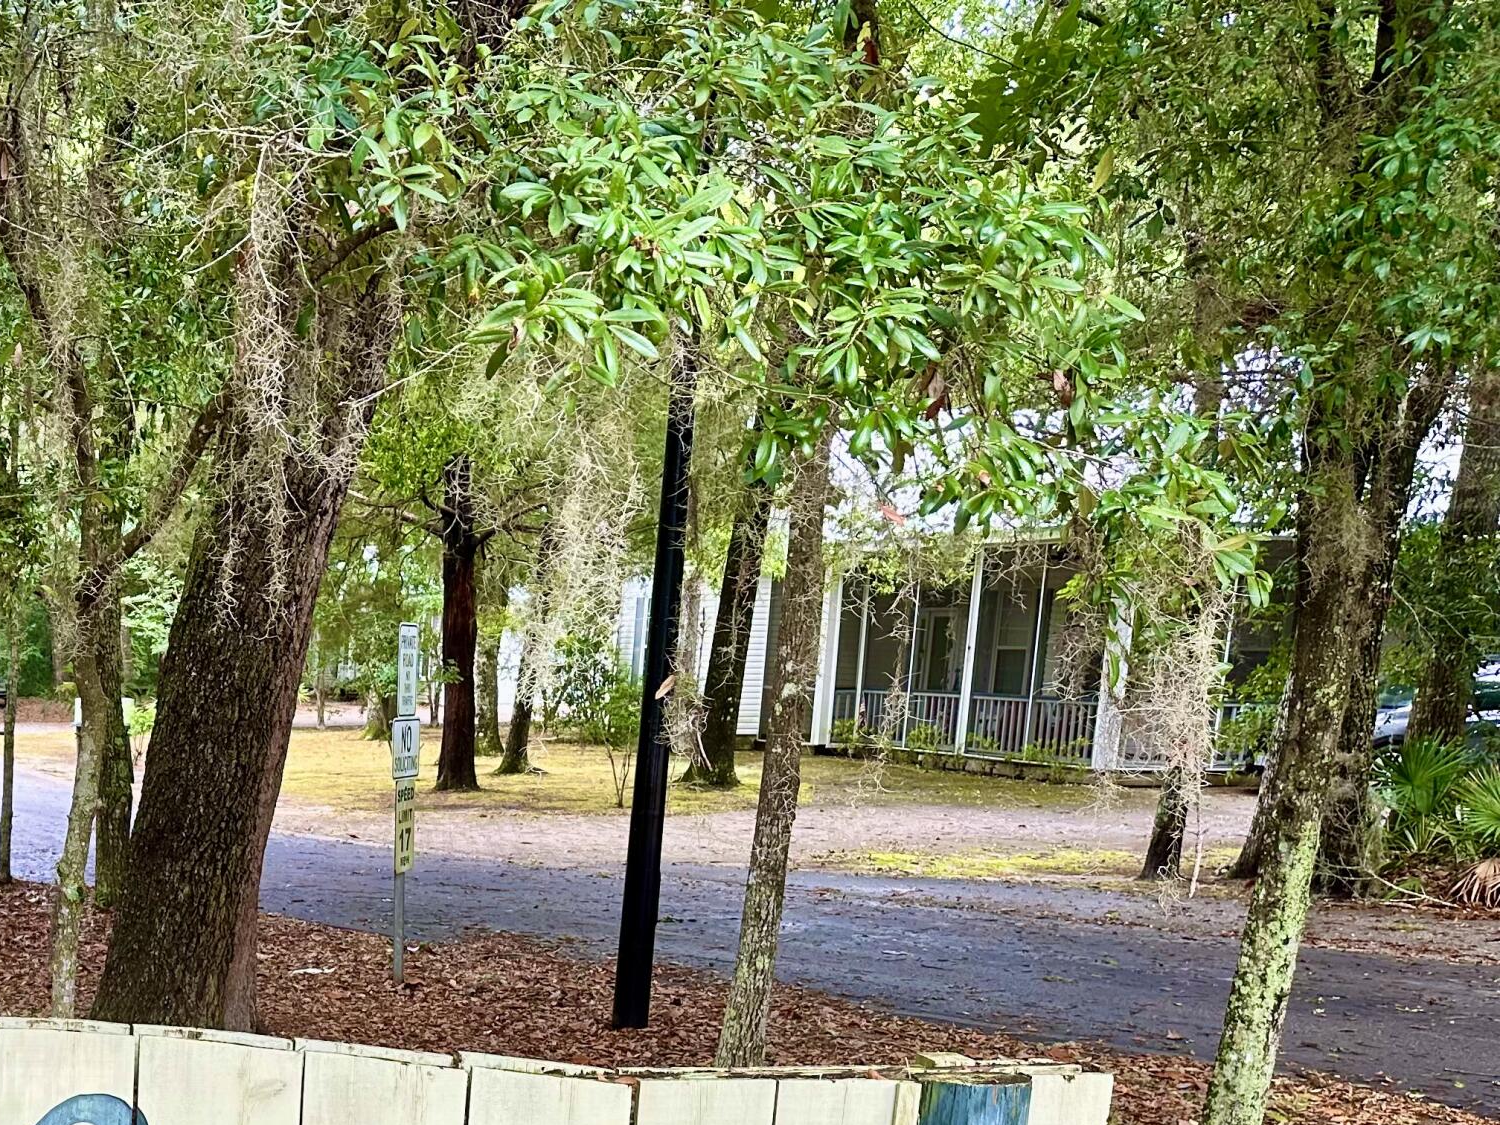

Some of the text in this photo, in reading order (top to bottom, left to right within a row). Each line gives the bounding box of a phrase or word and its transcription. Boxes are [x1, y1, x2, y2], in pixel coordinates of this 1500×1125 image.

[402, 635, 416, 649] PRIVATE
[403, 653, 414, 668] ROAD
[401, 724, 412, 753] NO
[395, 755, 418, 773] SOLICITING
[398, 785, 415, 803] SPEED
[399, 808, 413, 824] LIMIT
[399, 827, 412, 853] 17
